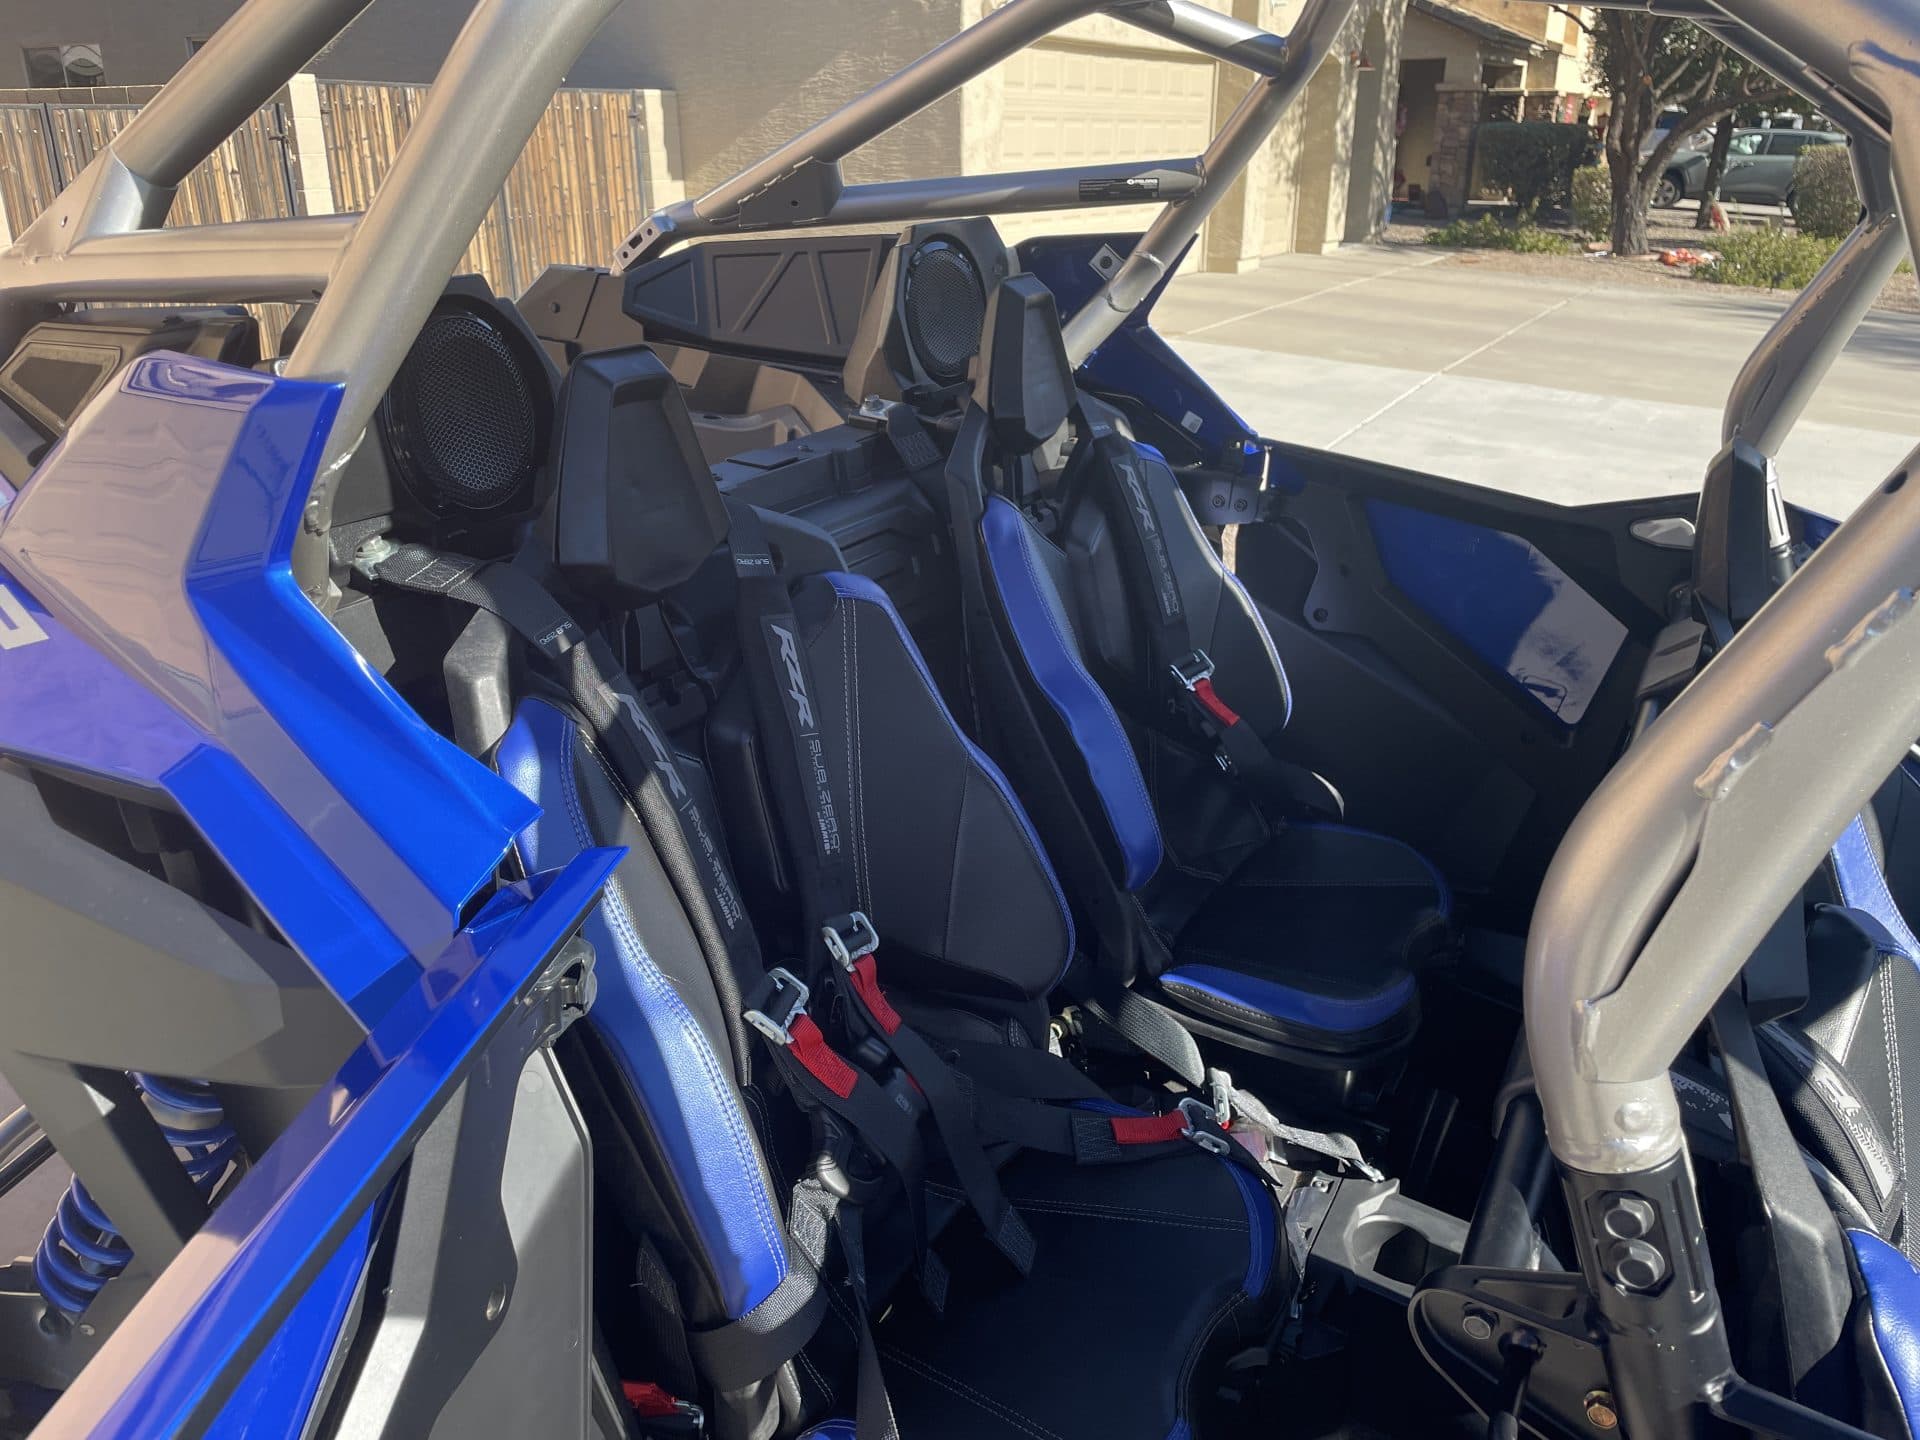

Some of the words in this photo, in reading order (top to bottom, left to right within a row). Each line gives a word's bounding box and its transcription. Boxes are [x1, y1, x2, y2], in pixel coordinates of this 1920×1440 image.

[1118, 463, 1155, 532] RZR
[613, 692, 687, 799] RZR
[771, 624, 814, 729] RZR
[810, 739, 828, 784] SUB
[821, 789, 840, 851] ZERO
